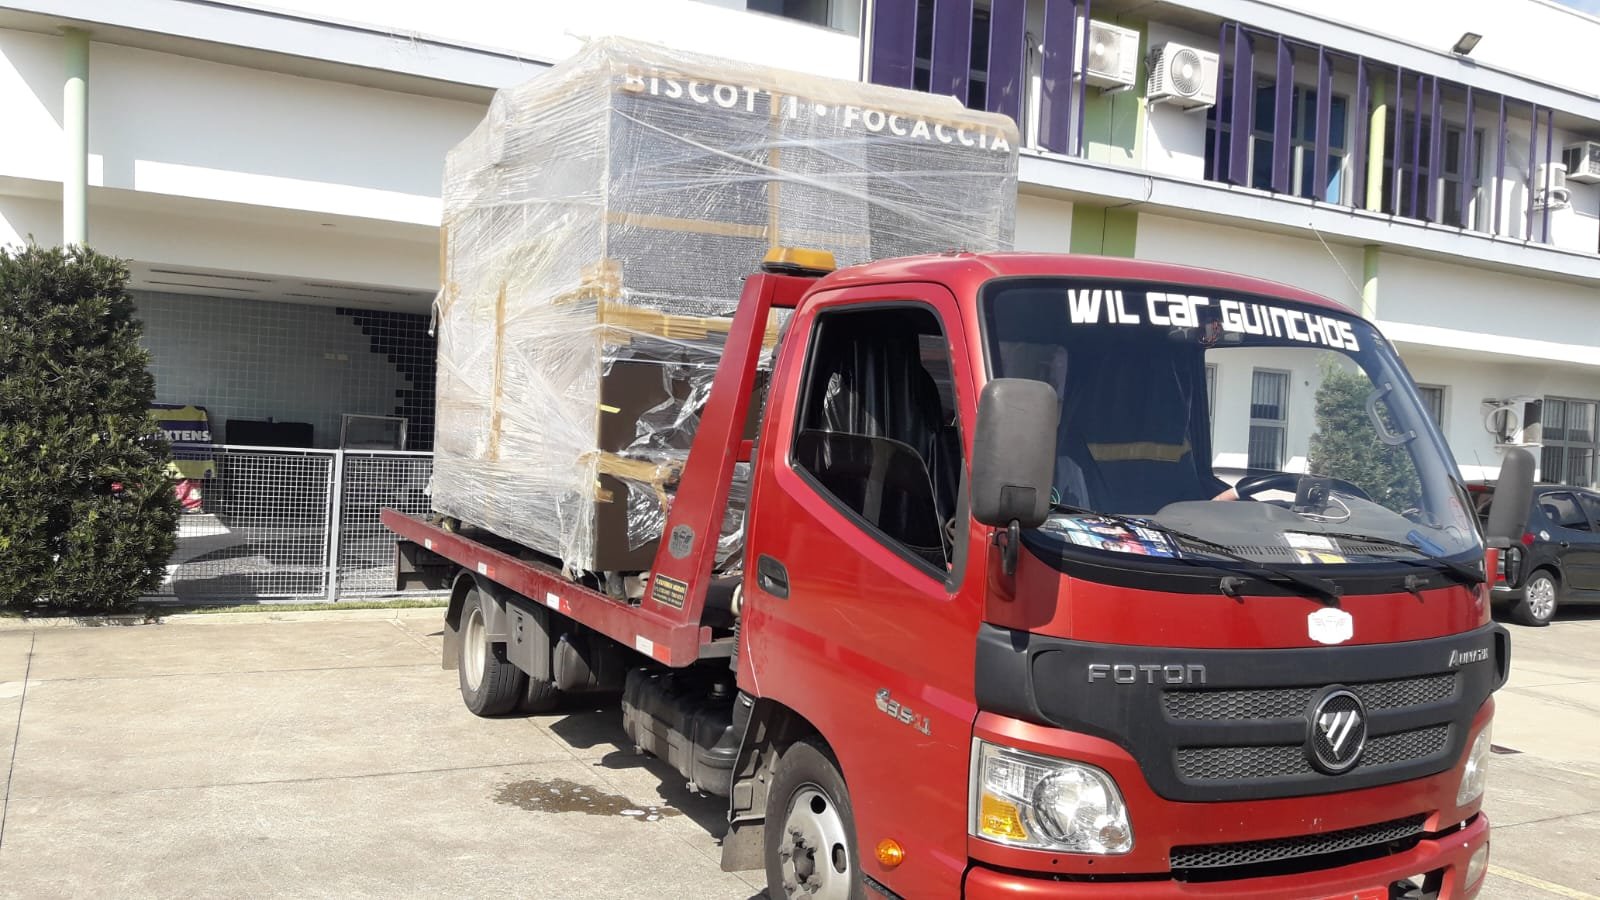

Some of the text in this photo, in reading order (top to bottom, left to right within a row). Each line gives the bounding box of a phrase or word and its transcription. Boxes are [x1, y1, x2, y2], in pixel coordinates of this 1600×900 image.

[623, 66, 1010, 153] BISCOTTI FOCACCIA
[1067, 288, 1140, 324] WIL
[1219, 298, 1360, 352] GUINCHOS
[1087, 664, 1207, 684] FOTON
